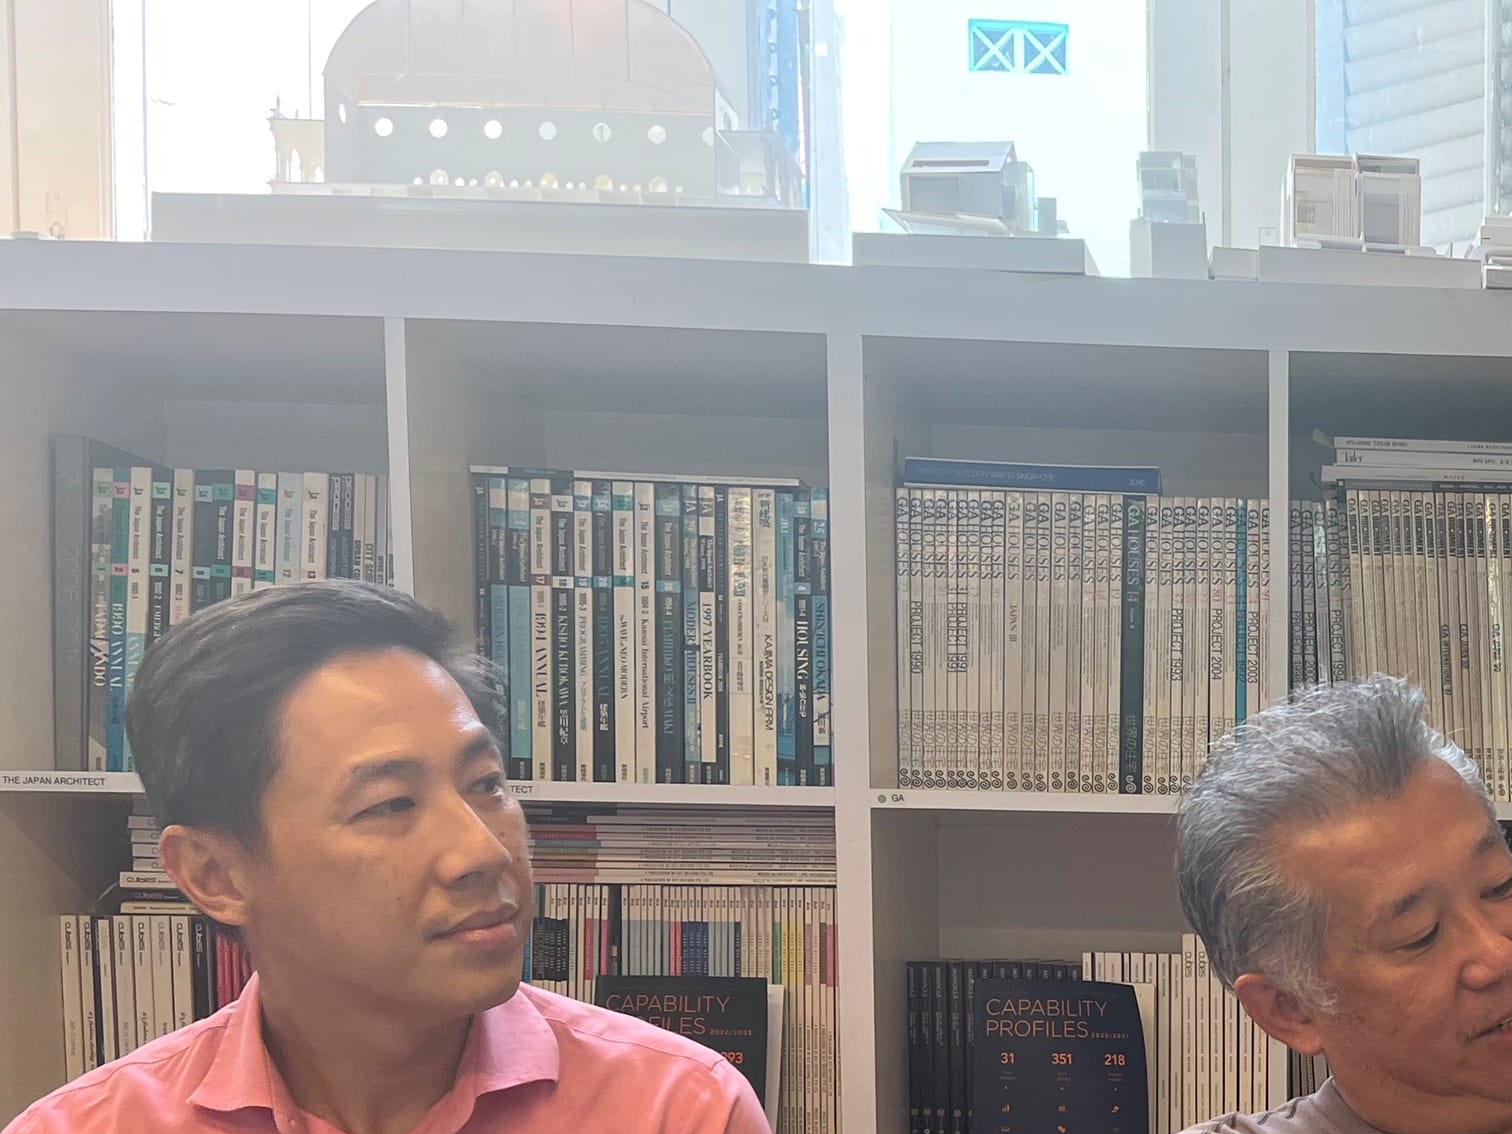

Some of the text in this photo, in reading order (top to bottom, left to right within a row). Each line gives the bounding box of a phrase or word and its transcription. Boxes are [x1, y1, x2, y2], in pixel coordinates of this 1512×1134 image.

[1110, 503, 1122, 524] GA
[1127, 505, 1140, 527] GA
[1212, 506, 1223, 527] GA
[992, 500, 1003, 579] GA HOUSES
[1007, 502, 1020, 580] GA HOUSES
[1110, 527, 1122, 581] HOUSES
[1127, 530, 1140, 585] HOUSES
[1212, 531, 1223, 585] HOUSES
[911, 498, 922, 674] GA HOUSES PROJECT 1990
[1247, 509, 1259, 683] GA HOUSES PROJECT 2003
[686, 600, 697, 645] MODER
[1008, 605, 1018, 628] JAPAN
[1212, 609, 1223, 654] PROJECT
[1332, 610, 1344, 655] PROJECT
[702, 602, 713, 700] 1997 YEARBOOK
[1212, 657, 1223, 680] 2004
[2, 775, 106, 786] THE JAPAN ARCHITECT
[510, 784, 533, 794] TECT
[891, 793, 904, 802] GA
[176, 923, 184, 951] cubes
[1184, 951, 1195, 978] cubes
[1198, 951, 1208, 978] cubes
[605, 994, 731, 1014] CAPABILITY
[985, 998, 1108, 1018] CAPABILITY
[639, 1016, 706, 1036] FILES
[985, 1019, 1089, 1039] PROFILES
[1000, 1052, 1016, 1065] 31
[1051, 1053, 1073, 1066] 351
[1104, 1053, 1126, 1067] 218
